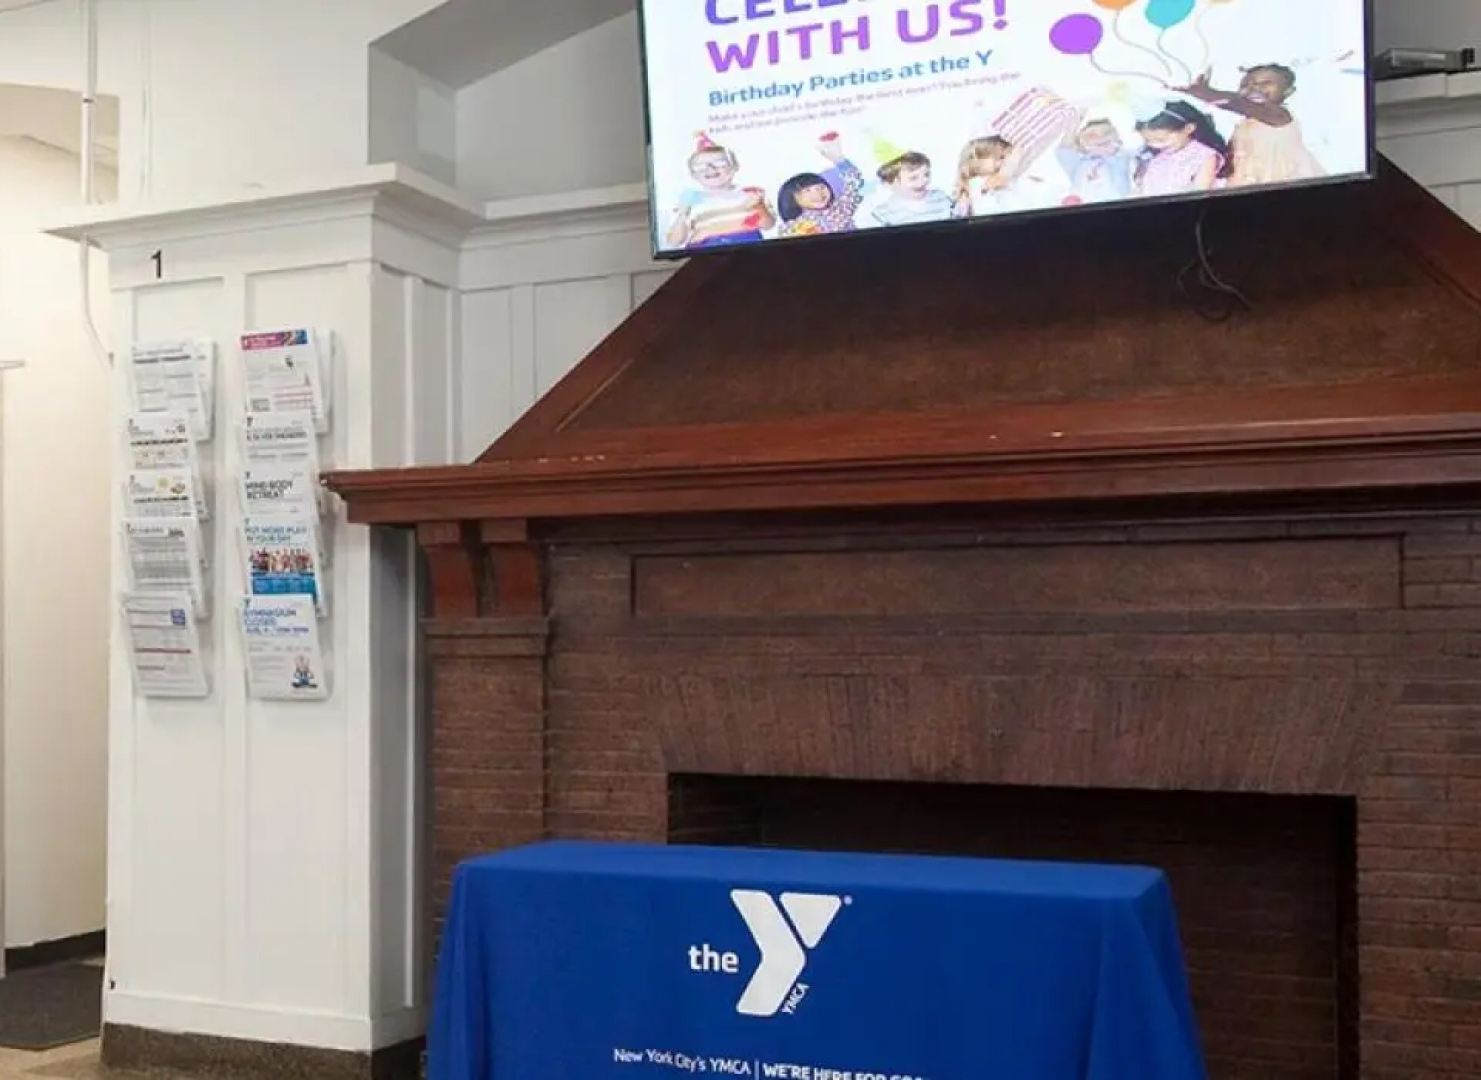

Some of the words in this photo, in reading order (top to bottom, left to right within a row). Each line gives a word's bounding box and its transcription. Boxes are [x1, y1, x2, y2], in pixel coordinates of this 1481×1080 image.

[705, 16, 870, 73] WITH
[896, 0, 1008, 43] US!
[708, 79, 804, 107] Birthday
[809, 66, 893, 92] Parties
[898, 61, 924, 79] at
[930, 55, 971, 74] the
[975, 49, 994, 66] Y
[150, 249, 162, 279] 1
[688, 943, 740, 973] the
[730, 889, 842, 1016] Y
[781, 982, 810, 1015] YMCA
[613, 1048, 643, 1063] New
[645, 1049, 673, 1065] York
[675, 1053, 706, 1073] City's
[709, 1058, 752, 1076] YMCA
[762, 1062, 811, 1080] WE'RE
